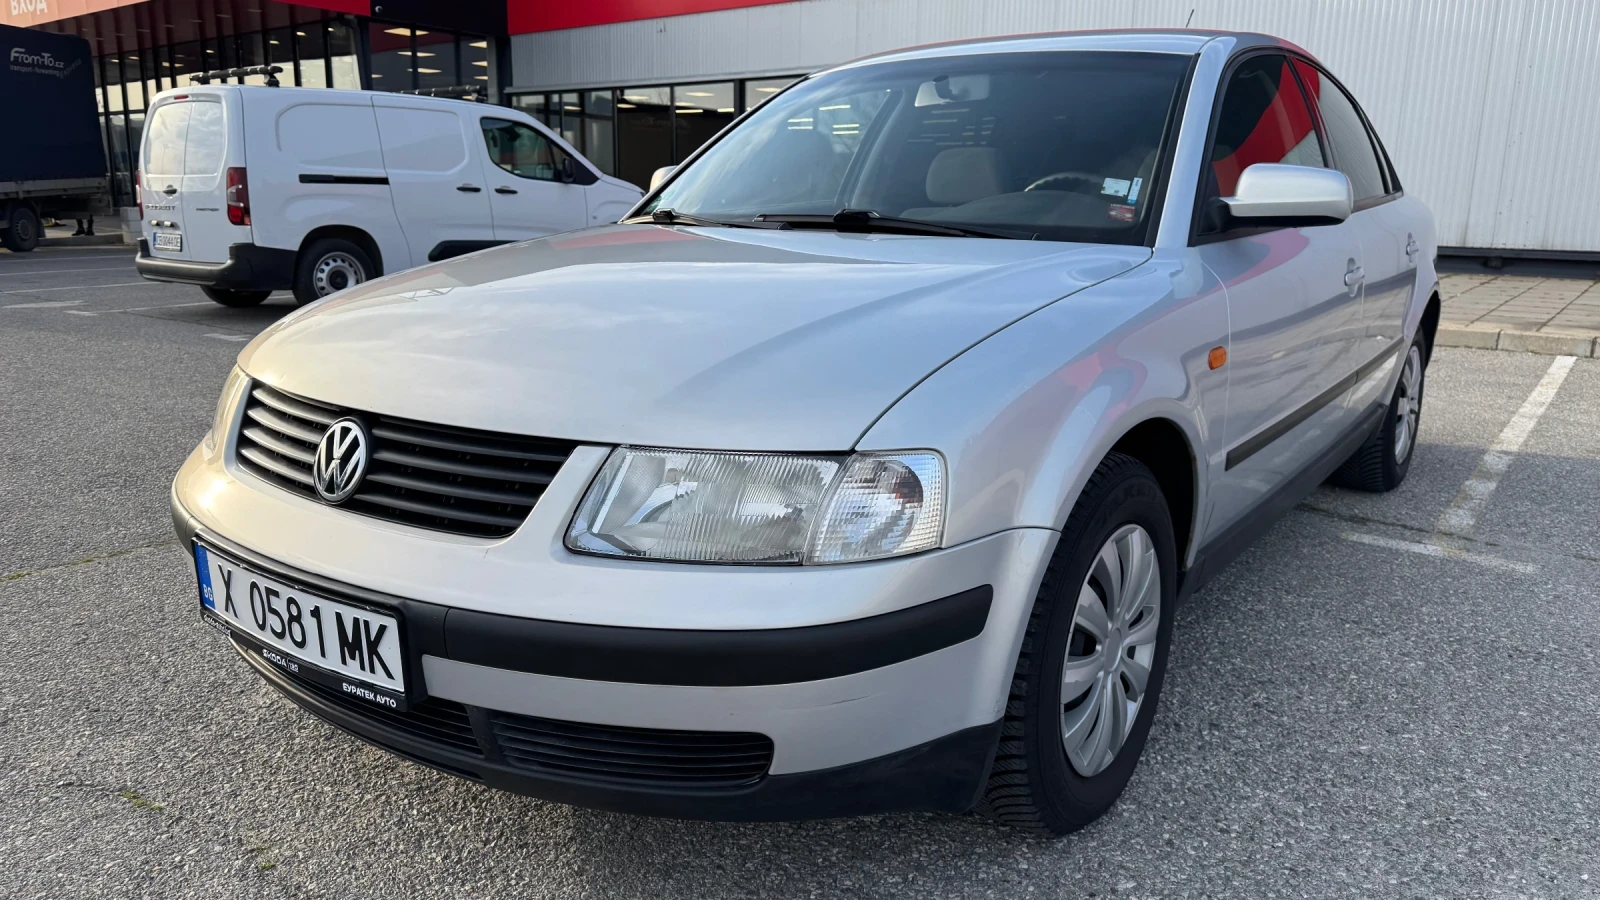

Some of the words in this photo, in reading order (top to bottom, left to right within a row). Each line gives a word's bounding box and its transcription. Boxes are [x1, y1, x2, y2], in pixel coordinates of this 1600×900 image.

[10, 47, 65, 69] From-To.cz
[203, 583, 213, 601] BG
[249, 580, 327, 660] 0581
[342, 682, 376, 701] ЕУРАТЕК
[376, 694, 397, 708] АУТО
